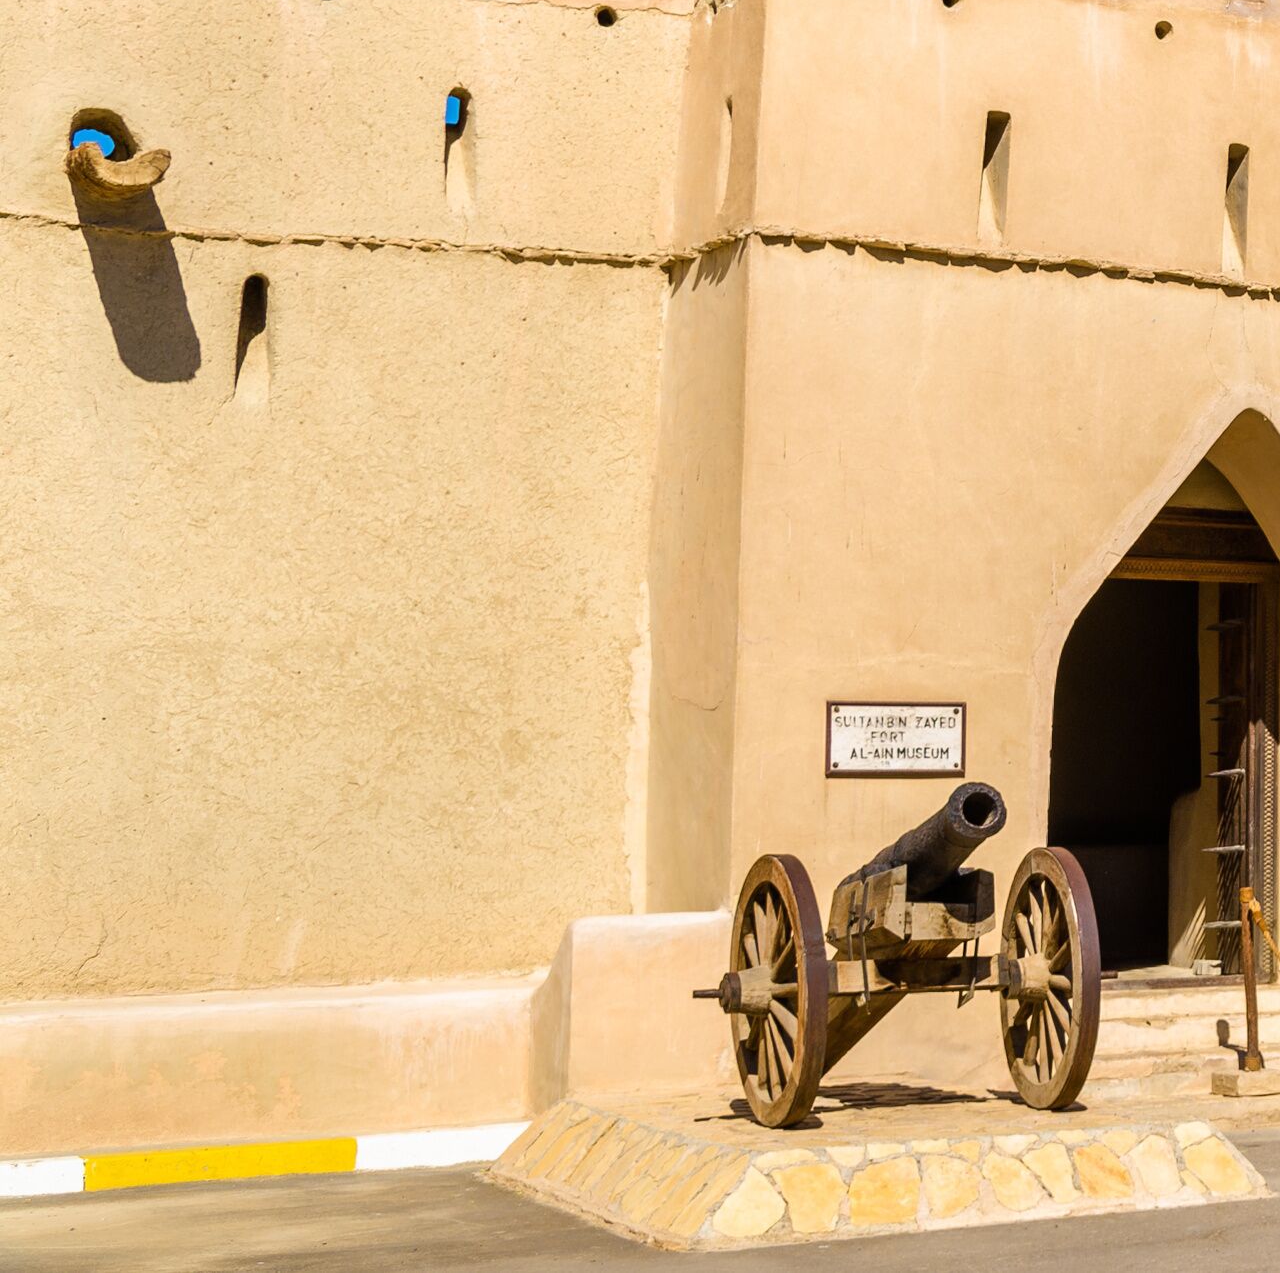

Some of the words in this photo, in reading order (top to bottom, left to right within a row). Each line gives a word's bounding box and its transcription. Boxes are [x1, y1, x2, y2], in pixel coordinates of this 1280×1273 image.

[915, 716, 957, 729] ZAYED
[870, 731, 906, 743] FORT
[850, 747, 894, 760] AL-AIN
[897, 747, 950, 760] MUSEUM
